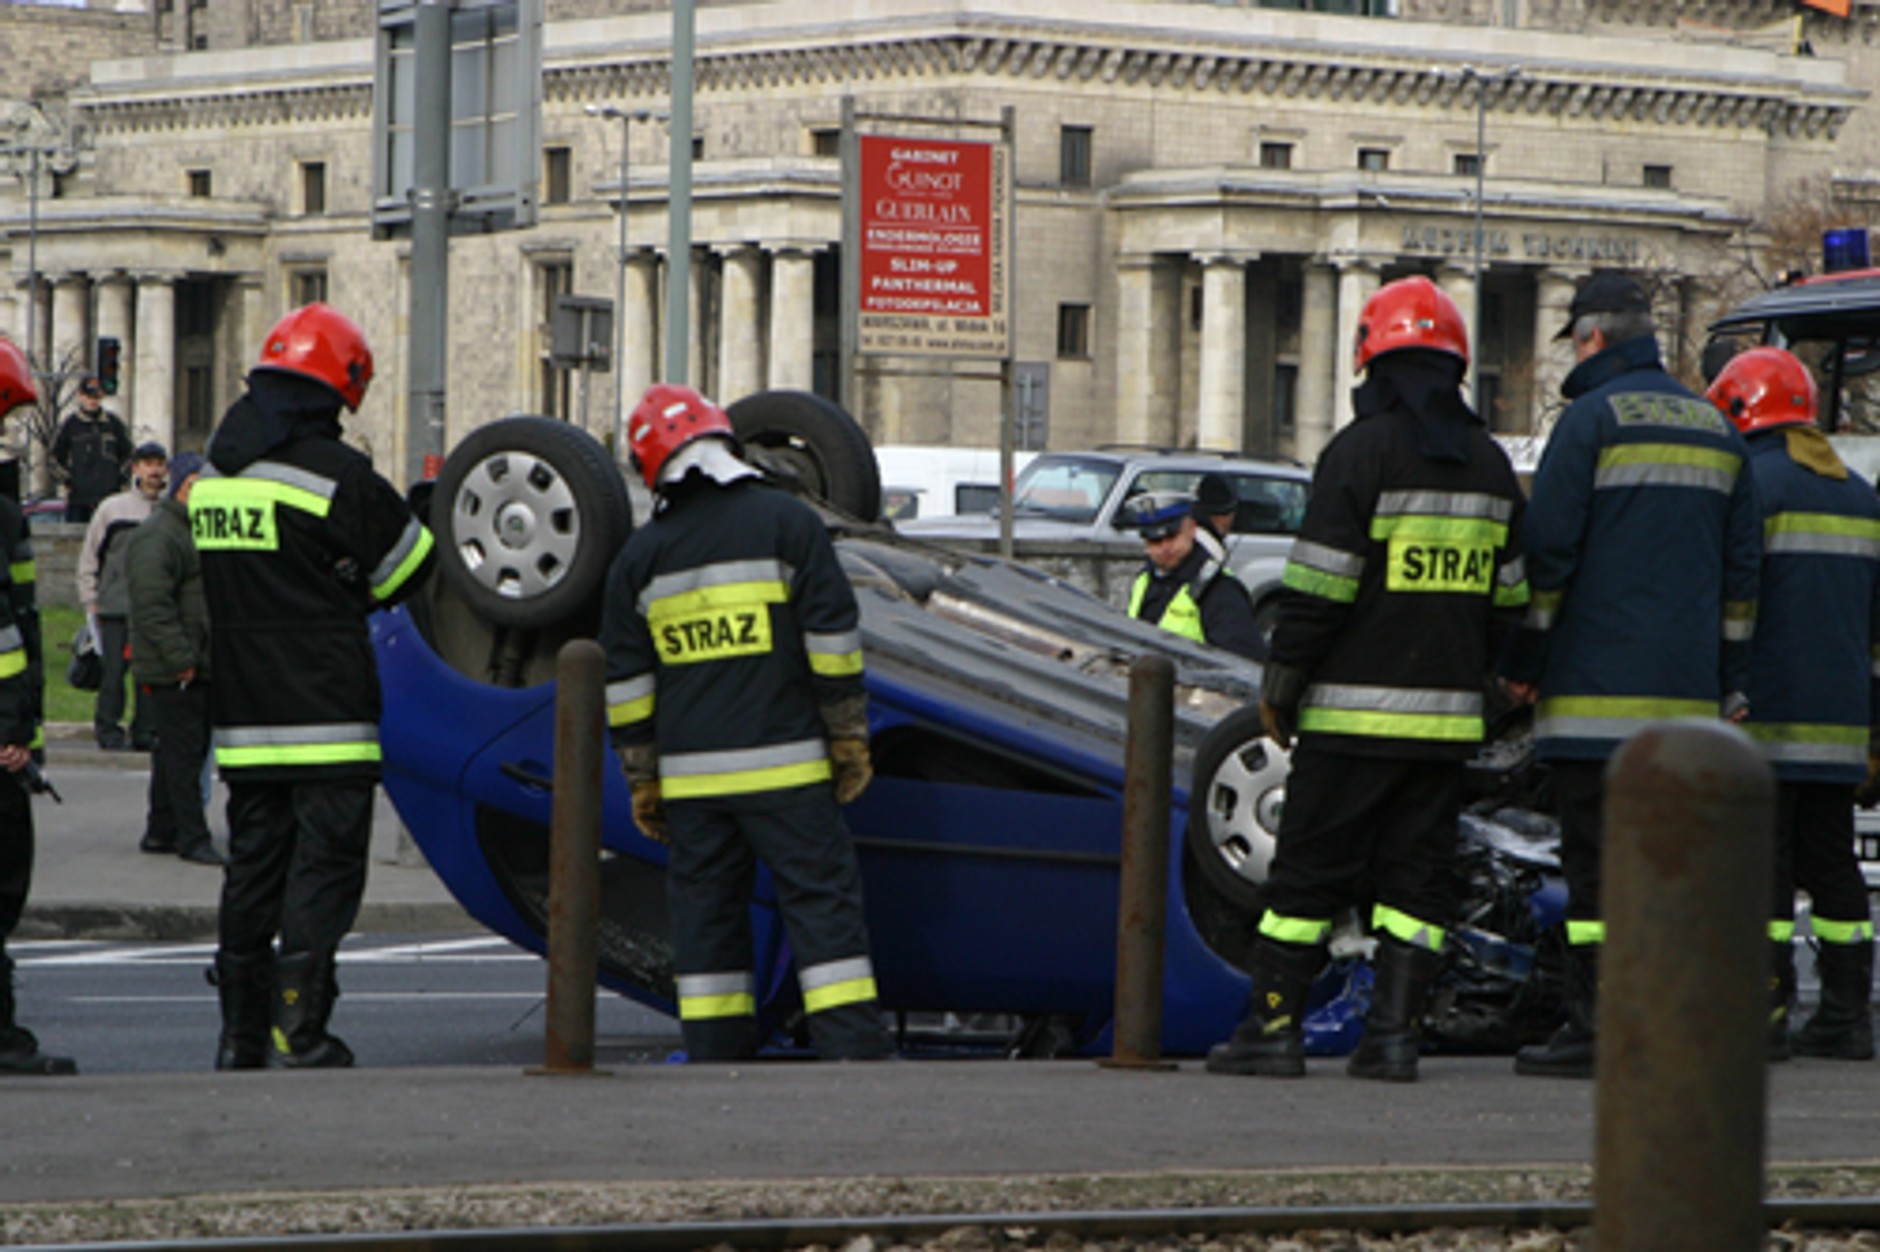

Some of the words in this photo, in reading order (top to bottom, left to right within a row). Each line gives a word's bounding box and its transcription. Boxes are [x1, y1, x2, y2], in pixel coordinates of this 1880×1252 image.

[891, 148, 959, 164] GABINET
[890, 259, 958, 273] SLIM-UP
[872, 277, 977, 294] PANTHERMAL
